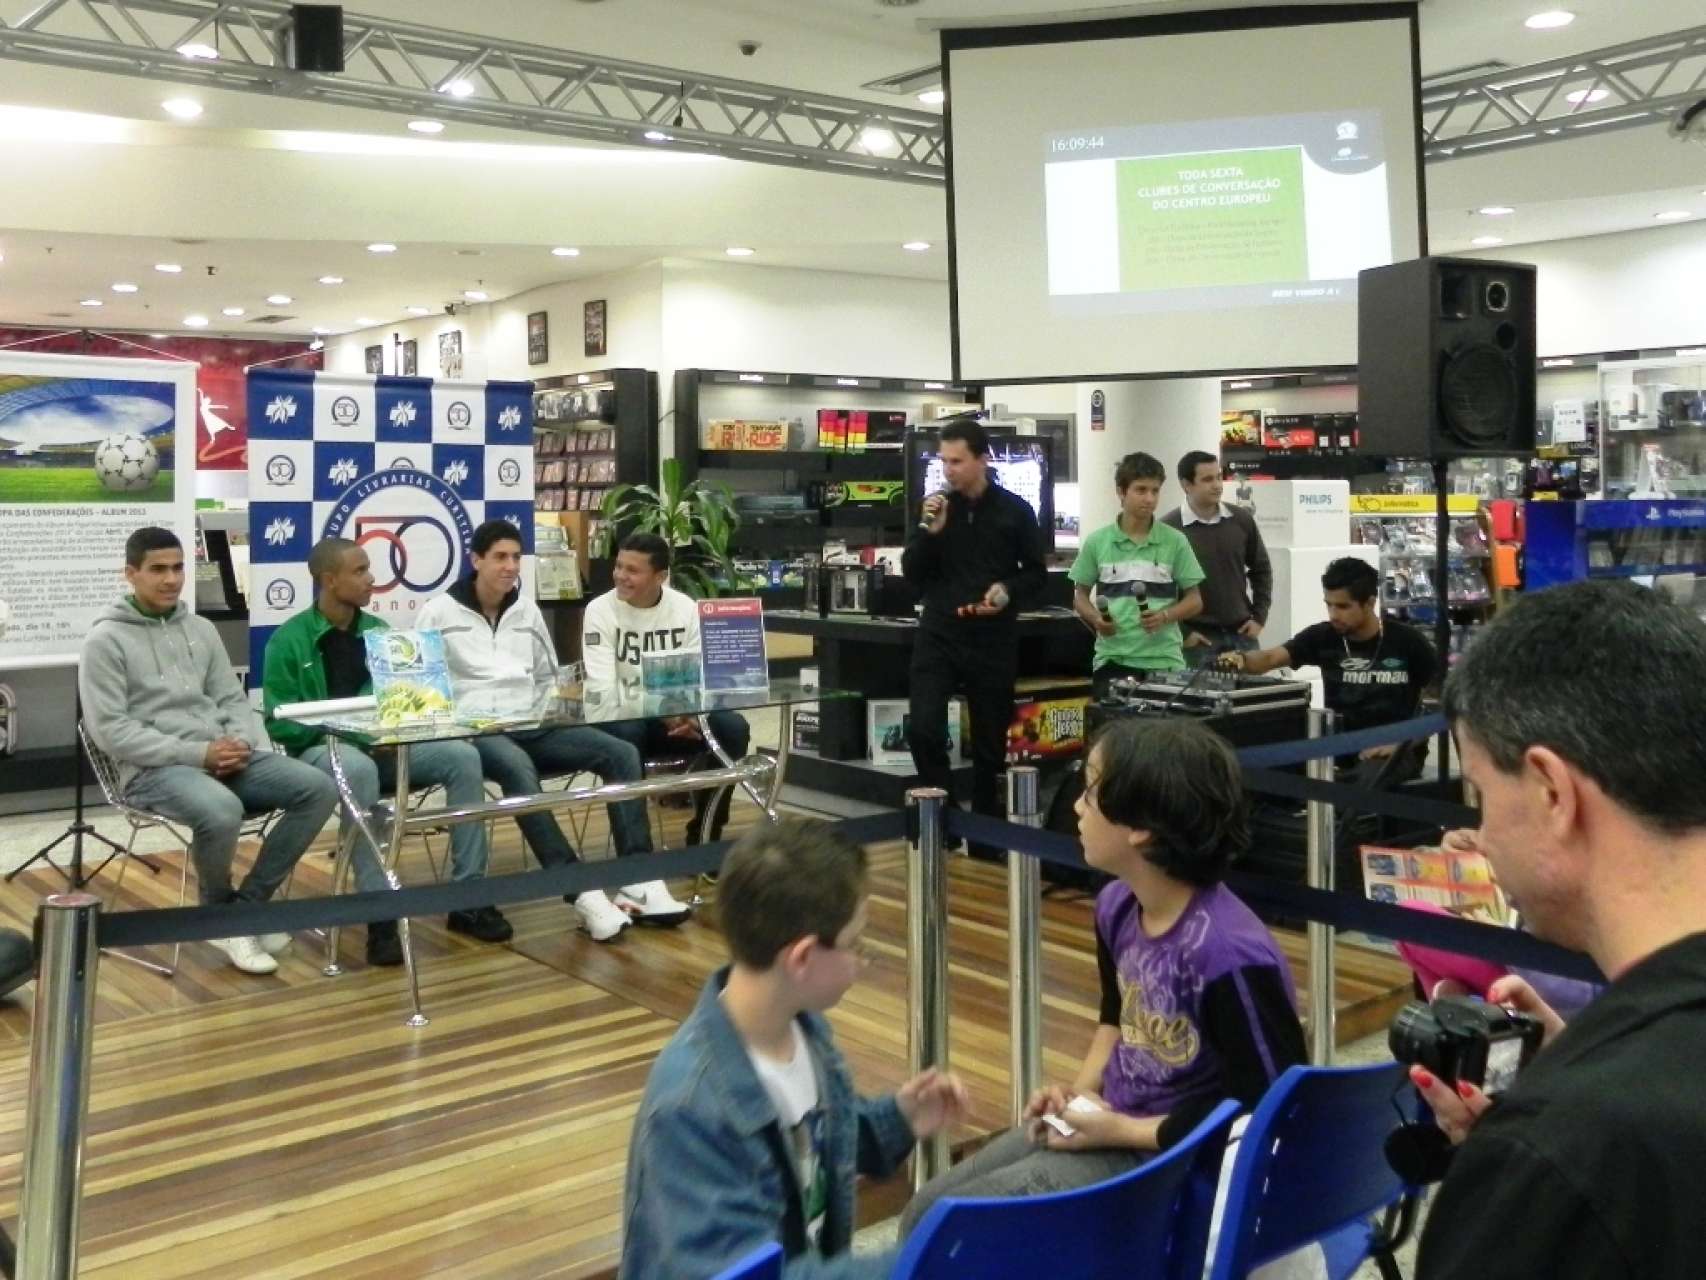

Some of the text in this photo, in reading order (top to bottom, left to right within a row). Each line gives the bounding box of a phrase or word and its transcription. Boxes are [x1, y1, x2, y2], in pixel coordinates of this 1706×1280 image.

[1052, 136, 1104, 152] 16:09:44
[1178, 166, 1244, 181] TODA SEXTA
[1137, 177, 1281, 198] CLUBES DE CONVERSAÇÃO
[1152, 192, 1271, 210] DO CENTRO EUROPEU
[357, 474, 432, 498] LIVRARIAS
[1299, 494, 1332, 505] PHILIPS
[356, 515, 455, 593] 50
